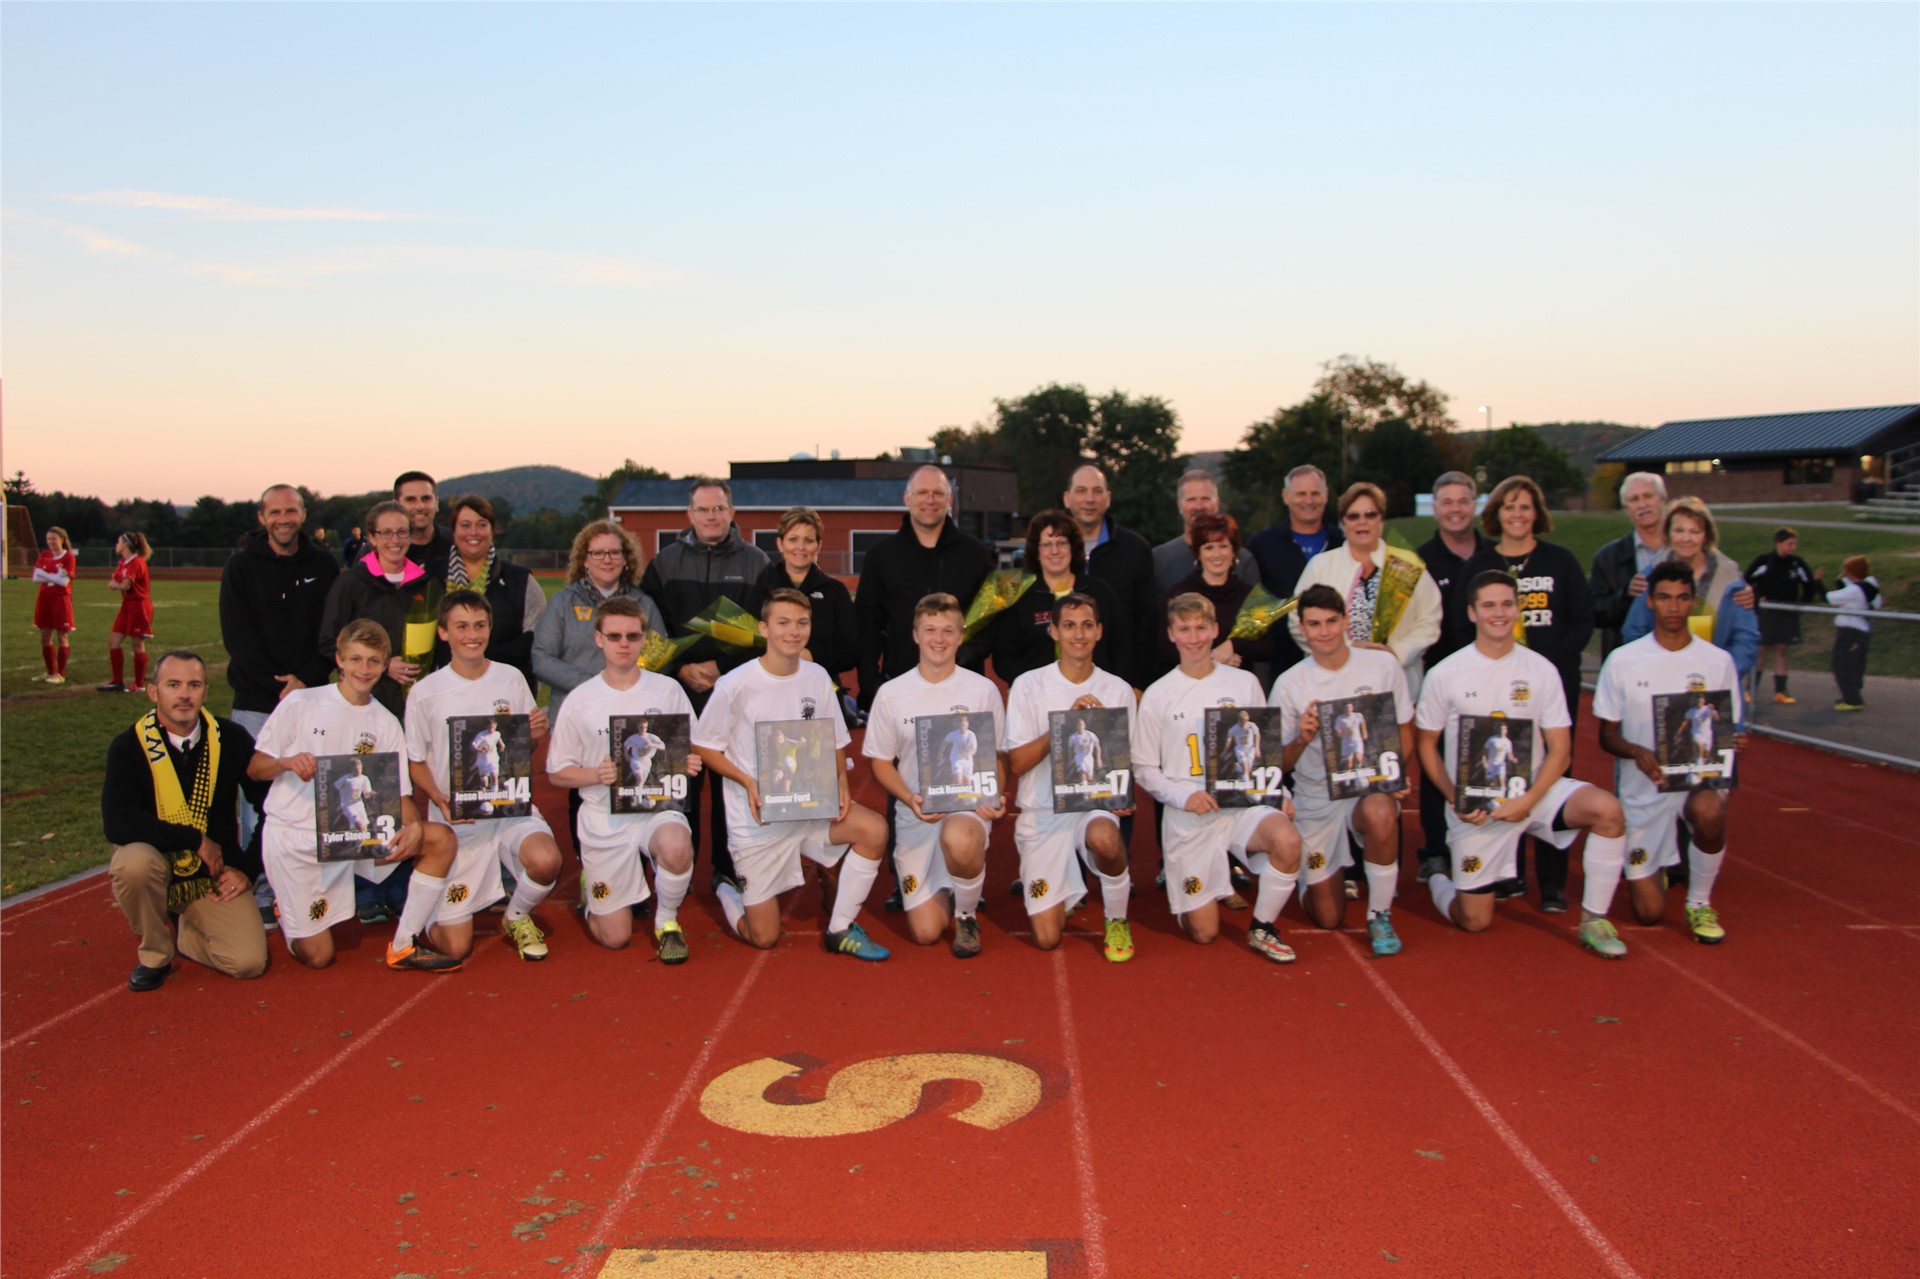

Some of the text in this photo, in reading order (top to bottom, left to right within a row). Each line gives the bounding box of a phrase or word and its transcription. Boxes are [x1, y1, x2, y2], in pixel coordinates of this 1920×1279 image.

[1187, 733, 1204, 776] 1
[1379, 751, 1400, 780] 6
[1717, 749, 1735, 778] 7
[503, 776, 531, 802] 14
[618, 786, 634, 796] Ben
[659, 773, 688, 799] 19
[927, 785, 945, 795] Jack
[970, 771, 997, 796] 15
[1105, 769, 1130, 795] 17
[1252, 766, 1283, 795] 12
[1507, 776, 1527, 799] 8
[455, 791, 477, 802] Jesse
[765, 792, 811, 804] Gunnar Ford
[322, 832, 343, 844] Tyler
[376, 815, 396, 846] 3
